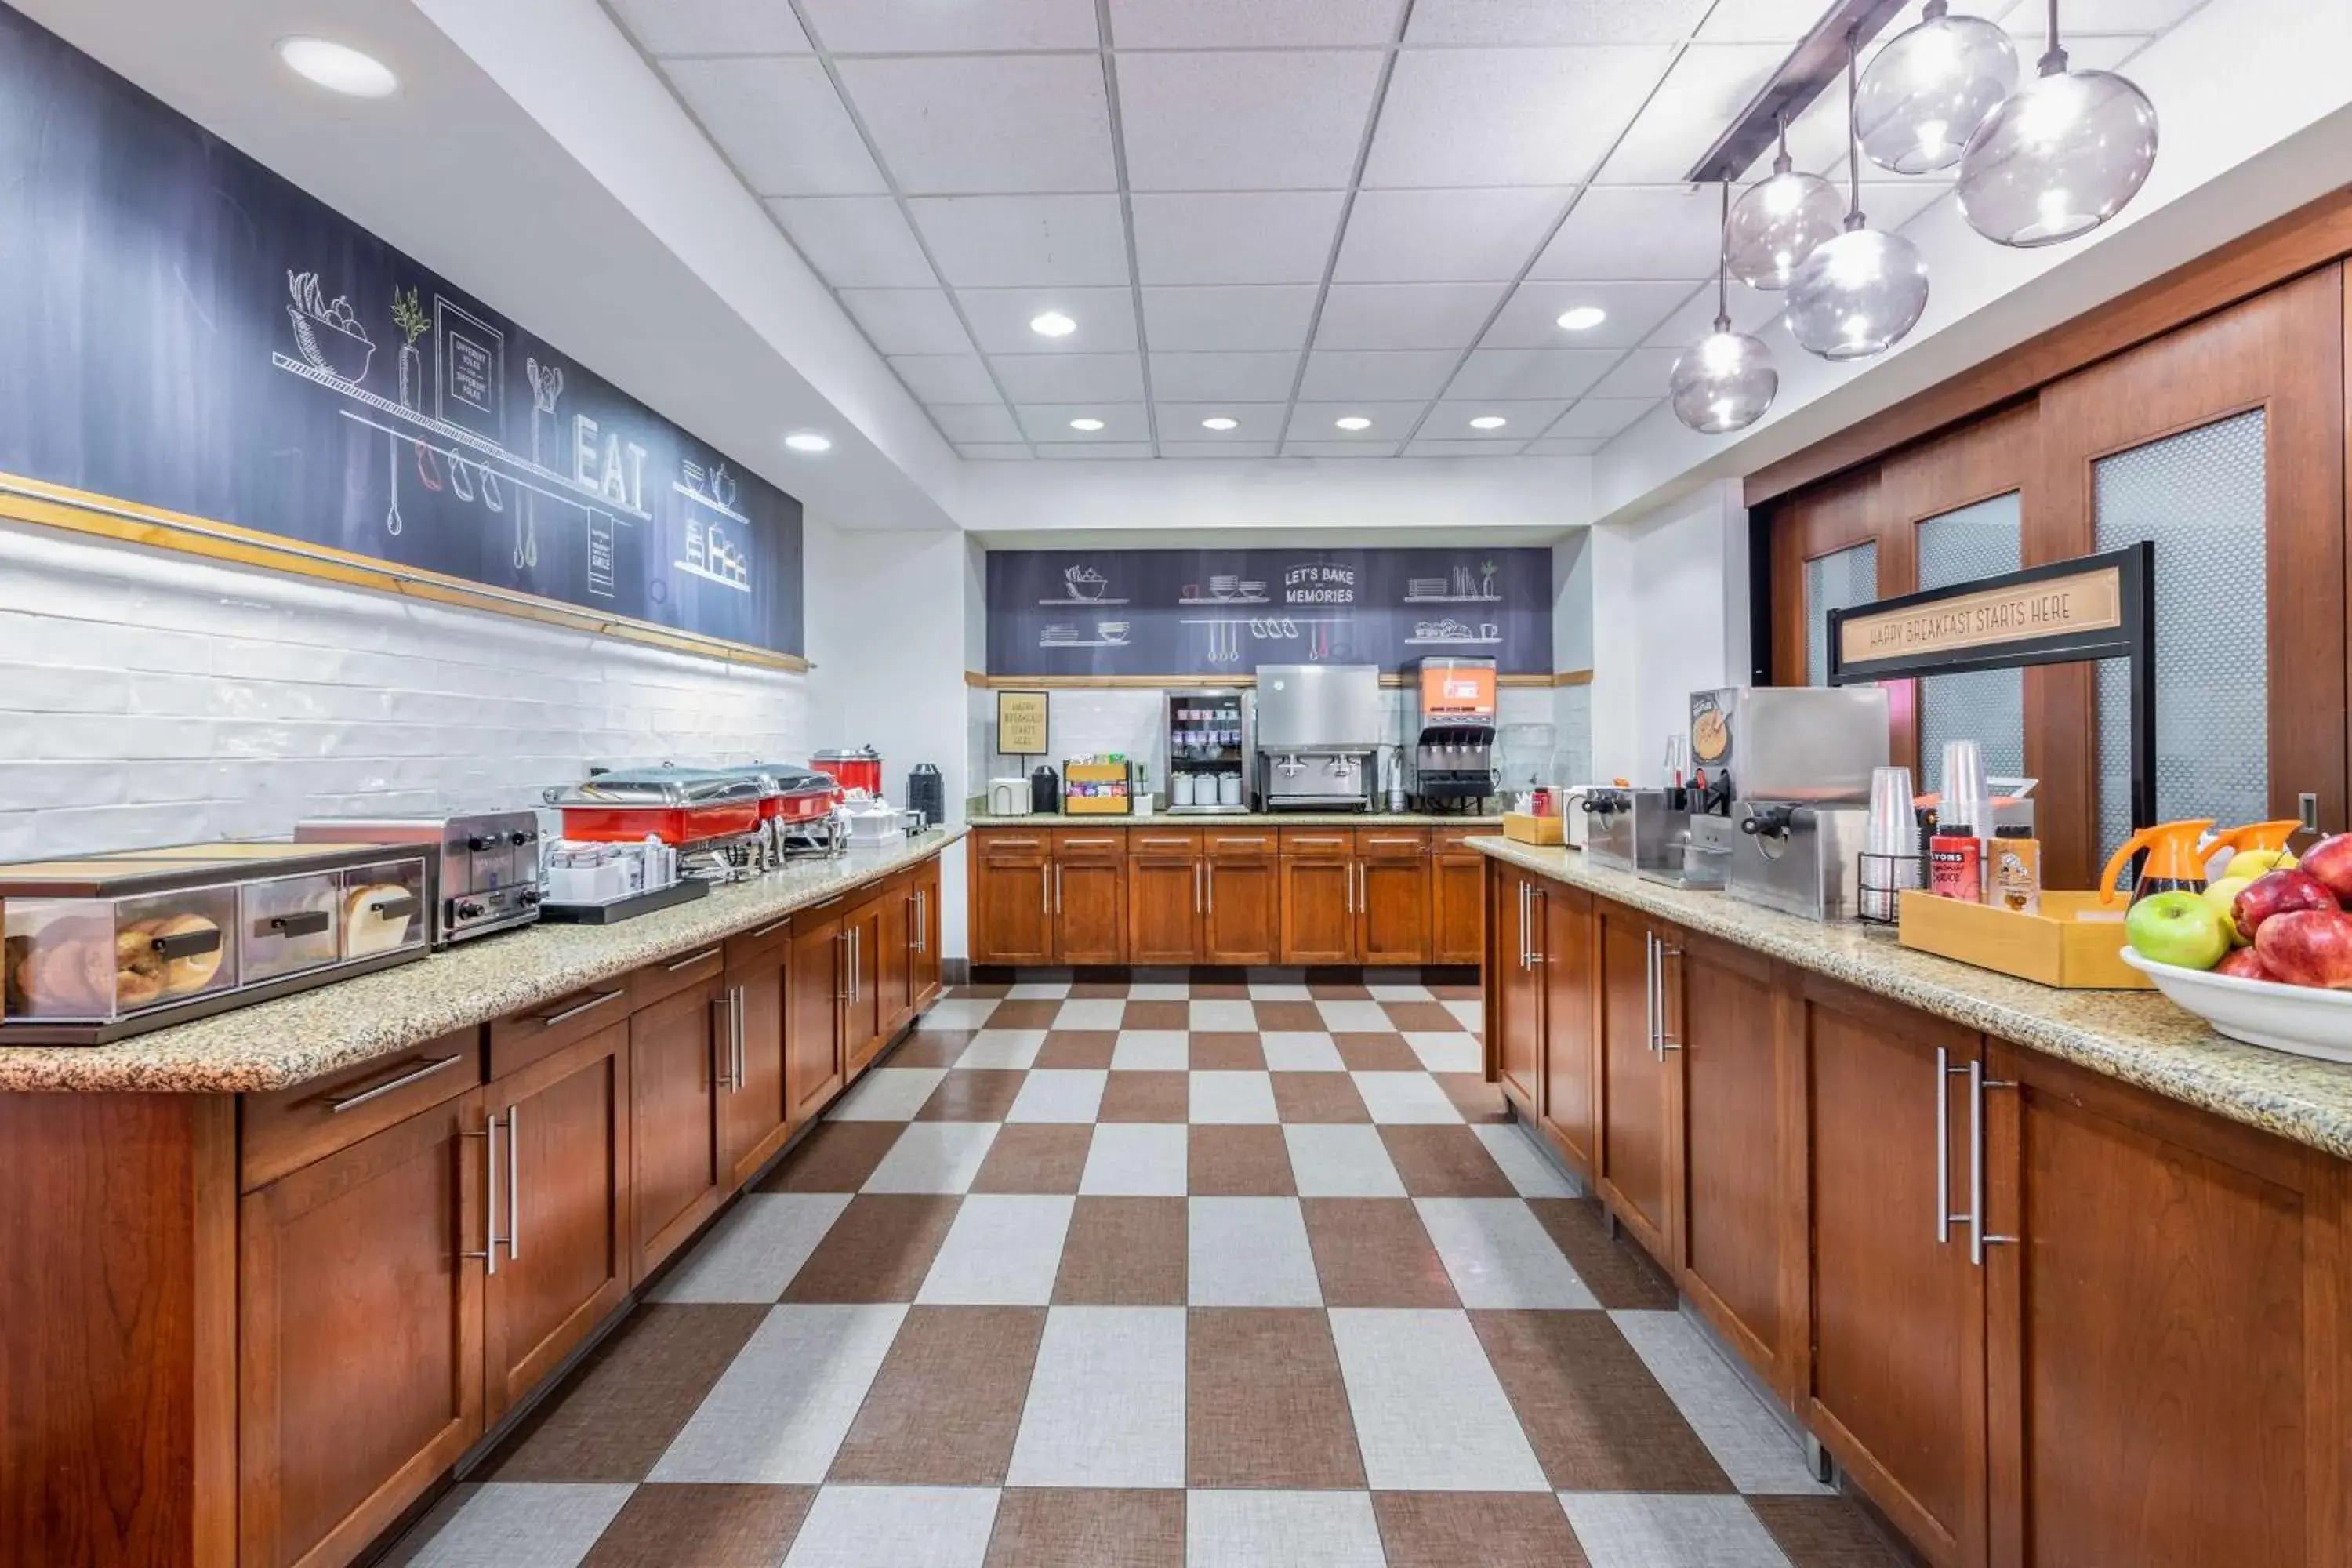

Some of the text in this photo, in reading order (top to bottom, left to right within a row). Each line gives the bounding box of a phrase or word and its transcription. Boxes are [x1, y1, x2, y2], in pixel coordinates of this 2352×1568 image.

[572, 413, 648, 511] EAT
[1285, 567, 1354, 586] LET'S BAKE
[1286, 589, 1354, 603] MEMORIES
[1869, 593, 2071, 648] HAPPY BREAKFAST STARTS HERE
[1931, 853, 1962, 862] LYONS
